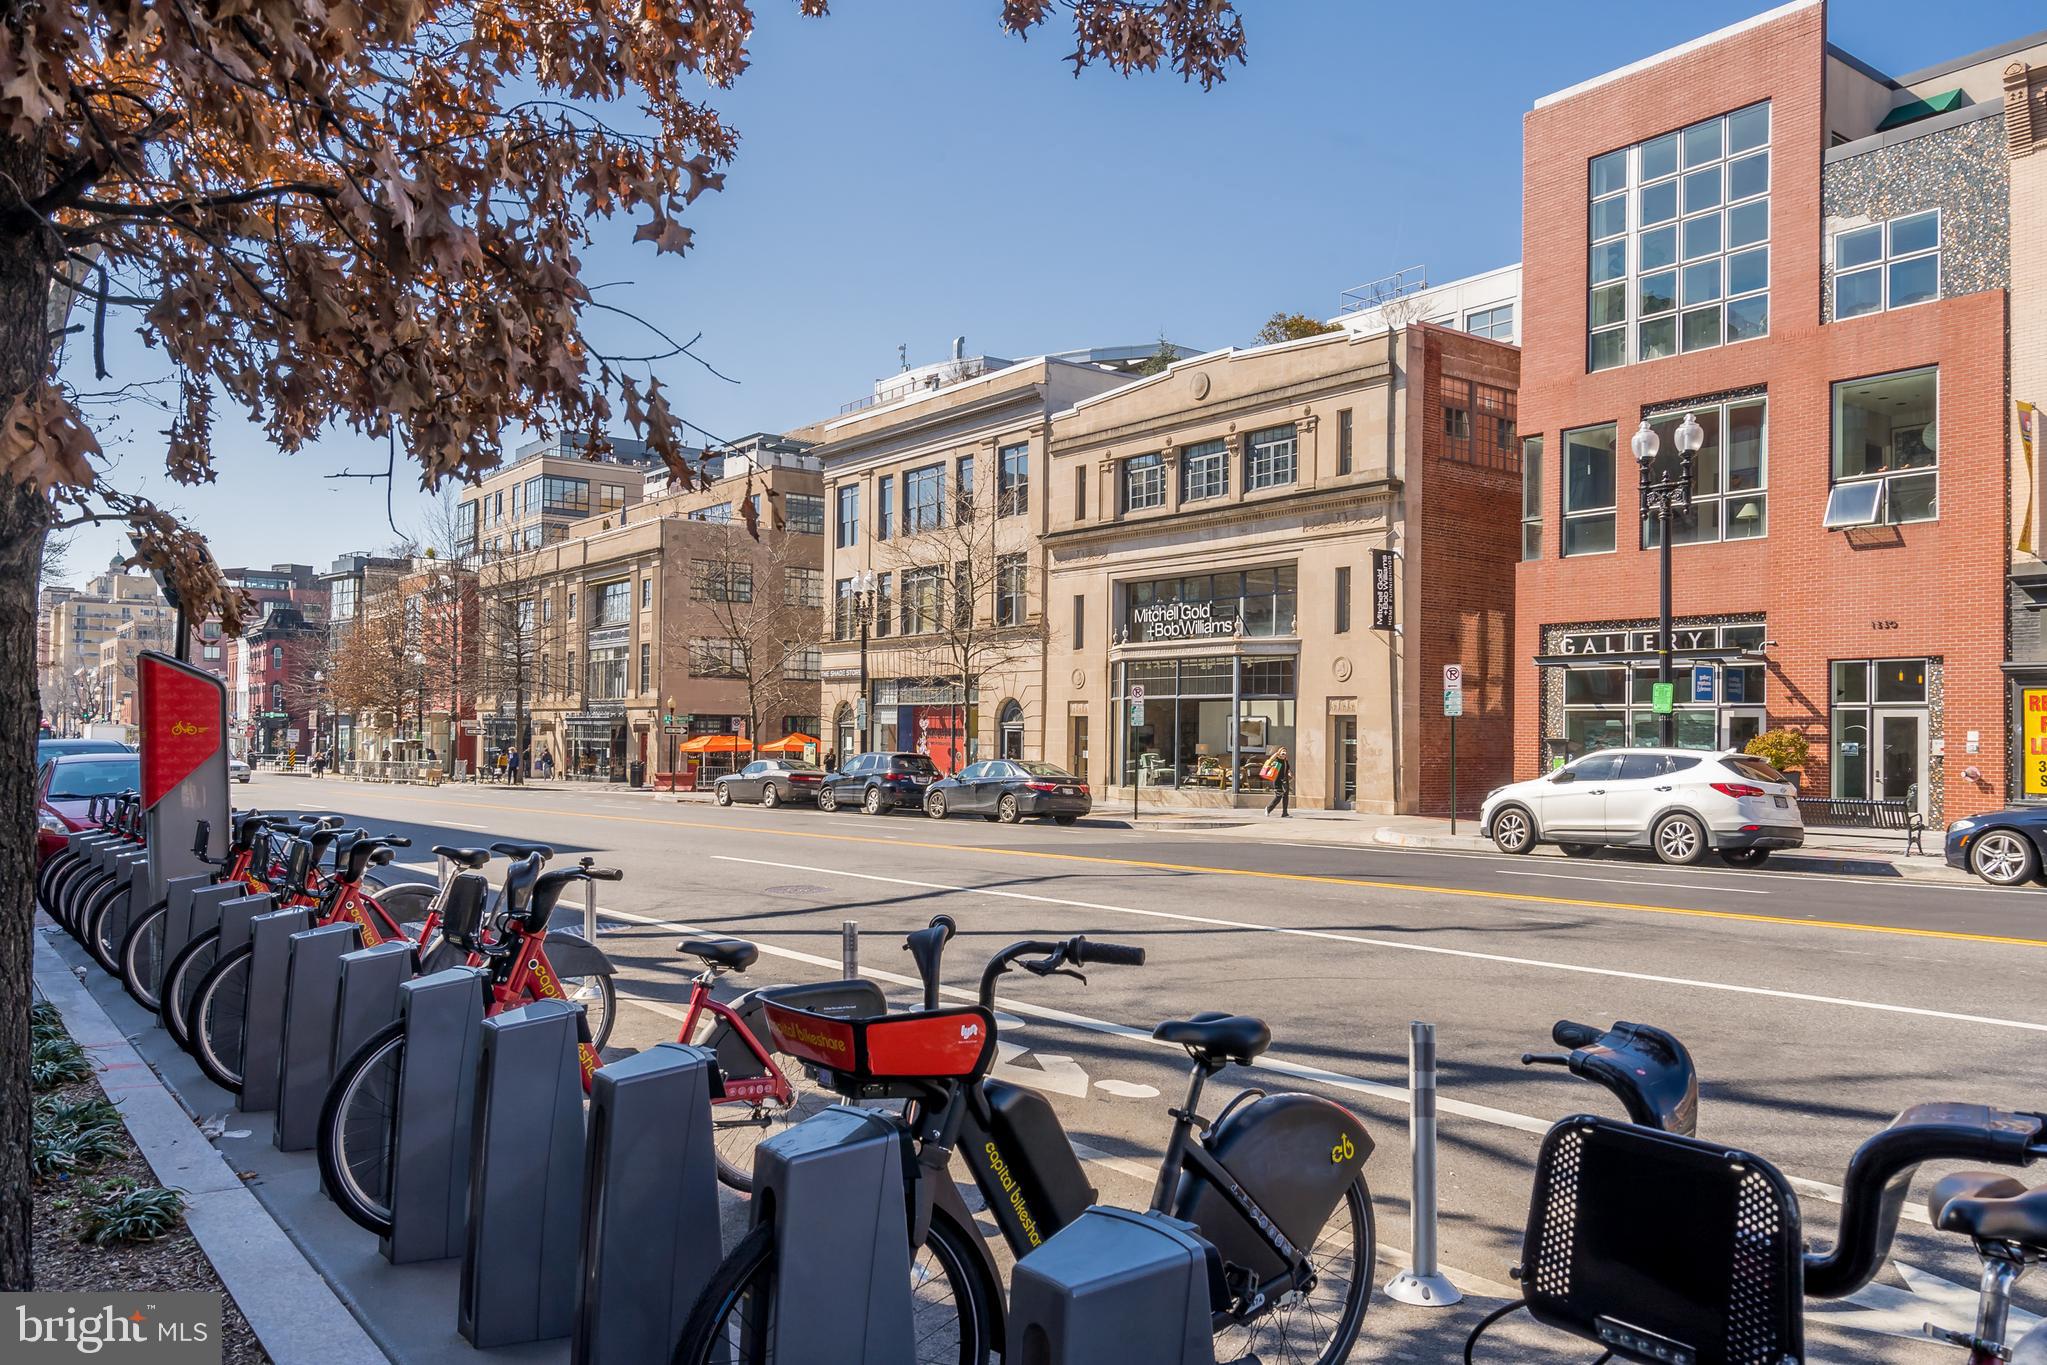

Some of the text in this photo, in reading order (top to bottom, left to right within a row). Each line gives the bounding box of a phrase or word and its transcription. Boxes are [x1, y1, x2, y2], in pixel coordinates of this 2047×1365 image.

[1134, 602, 1210, 624] Mitchell Gold
[1147, 620, 1233, 637] +Bob Williams
[796, 1023, 846, 1052] bikeshare
[985, 1142, 1042, 1248] capital bikeshar
